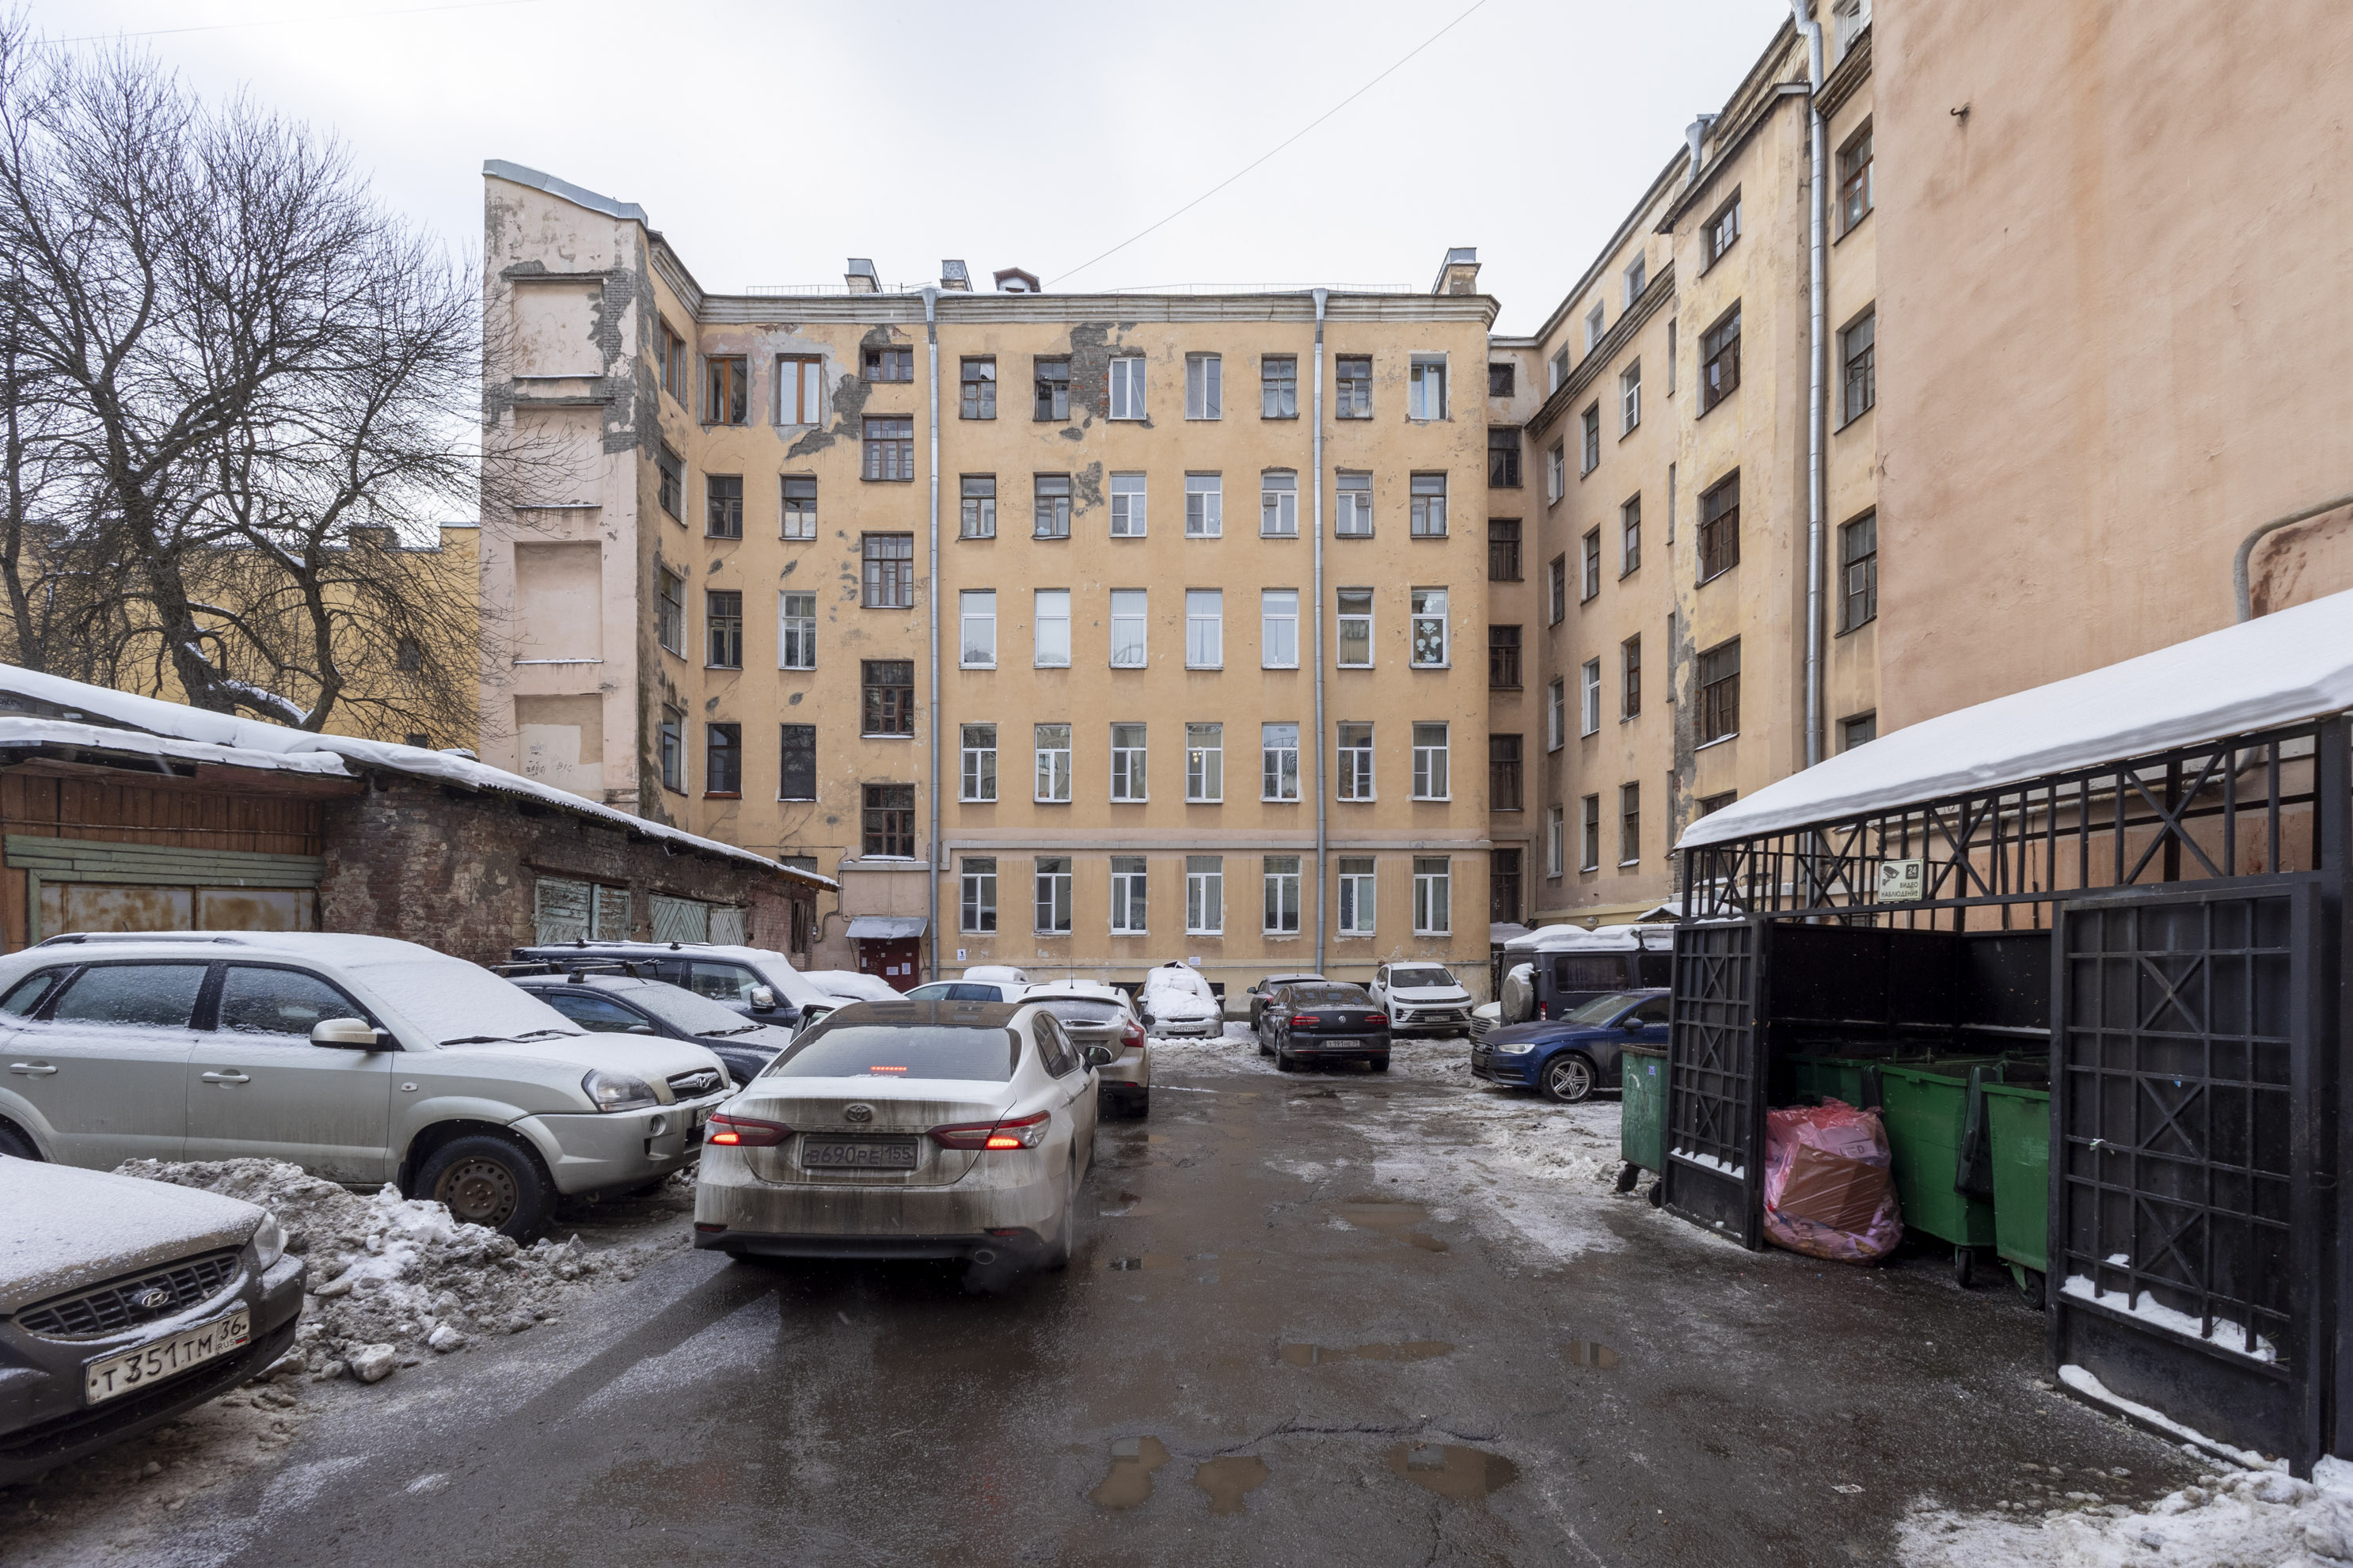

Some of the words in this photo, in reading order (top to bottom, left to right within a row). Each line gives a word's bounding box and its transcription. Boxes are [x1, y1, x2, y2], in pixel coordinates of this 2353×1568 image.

[1908, 866, 1917, 875] 24
[218, 1338, 235, 1350] RUS
[102, 1334, 212, 1391] Т351ТМ
[220, 1316, 241, 1339] 36
